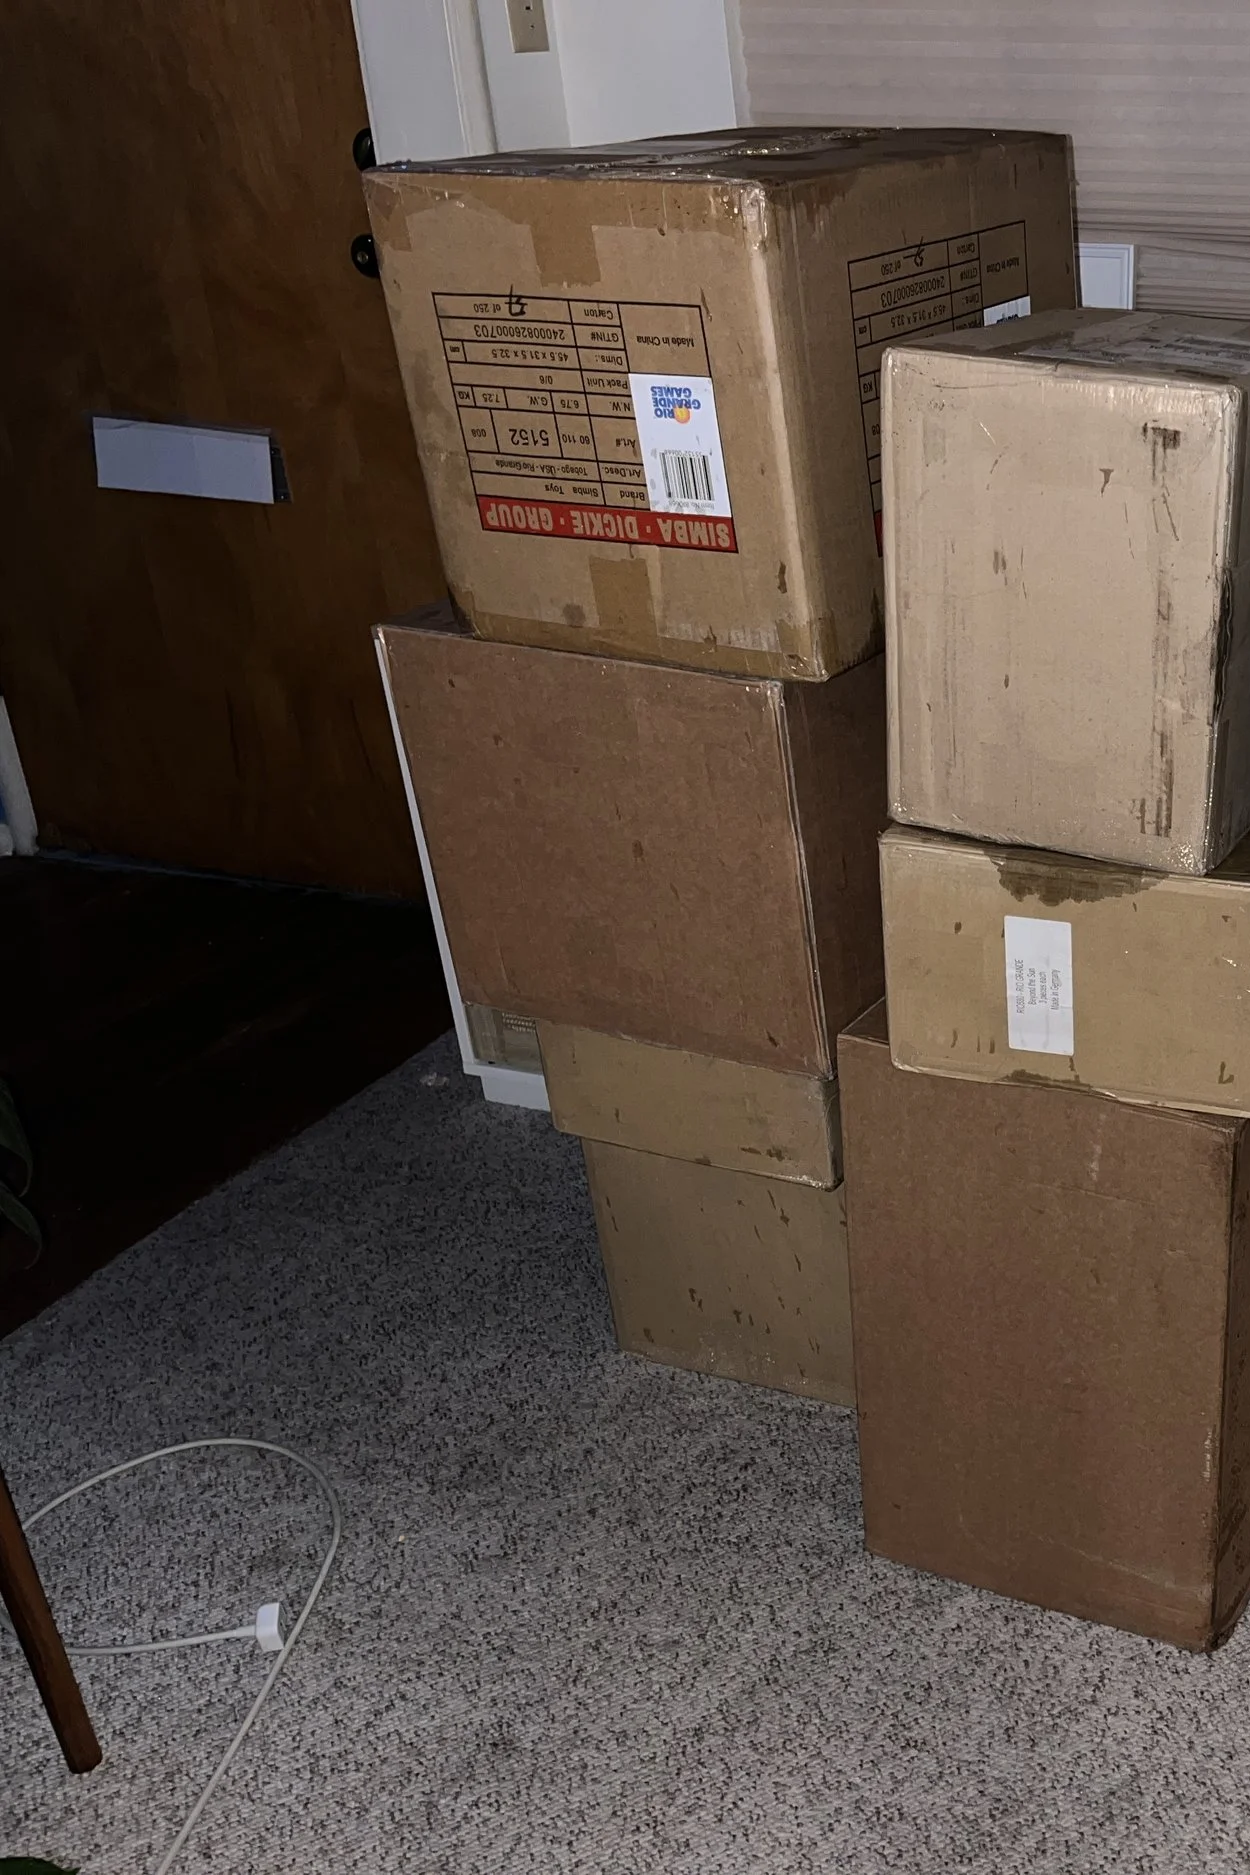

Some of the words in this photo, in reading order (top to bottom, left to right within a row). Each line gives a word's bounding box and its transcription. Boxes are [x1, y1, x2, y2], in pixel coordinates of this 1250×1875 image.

[957, 243, 975, 255] Carton
[880, 263, 893, 276] 250
[893, 260, 902, 269] of
[473, 302, 488, 312] 250
[492, 303, 500, 311] of
[583, 308, 612, 319] Carton
[473, 324, 564, 340] 24000826000703
[590, 331, 618, 342] GTIN#
[636, 335, 660, 346] China
[661, 337, 669, 345] in
[671, 336, 694, 347] Made
[491, 348, 509, 359] 32.5
[520, 349, 539, 360] 31.5
[549, 351, 568, 362] 45.5
[594, 354, 622, 365] Dims.:
[539, 374, 552, 385] 0/6
[586, 377, 604, 387] Unit
[606, 379, 627, 390] Pack
[650, 386, 691, 398] GAMES
[862, 382, 874, 394] KG
[458, 391, 470, 400] KG
[481, 393, 499, 403] 7.25
[526, 395, 548, 407] G.W.
[559, 399, 579, 409] 6.75
[609, 402, 631, 412] N.W.
[651, 397, 700, 409] GRANDE
[654, 408, 675, 419] RIO
[470, 428, 487, 438] 008
[871, 424, 881, 436] 08
[508, 428, 550, 446] 5152
[561, 434, 576, 443] 110
[615, 438, 635, 448] Art.#
[494, 459, 521, 470] Grande
[523, 462, 534, 472] Rio
[539, 465, 555, 474] USA
[560, 464, 587, 476] Tobago
[601, 467, 641, 477] Art.Desc.
[544, 482, 565, 495] Toys
[572, 486, 599, 497] Simba
[619, 490, 646, 501] Brand
[484, 502, 553, 531] GROUP
[569, 510, 640, 540] DICKIE
[655, 518, 730, 547] SIMBA
[1015, 958, 1025, 980] GRANDE
[1027, 967, 1036, 977] Sun
[1028, 978, 1037, 986] the
[1039, 971, 1048, 983] each
[1051, 969, 1061, 990] Germany
[1028, 986, 1038, 1005] Beyond
[1039, 984, 1049, 999] pieces
[1051, 997, 1060, 1010] Made
